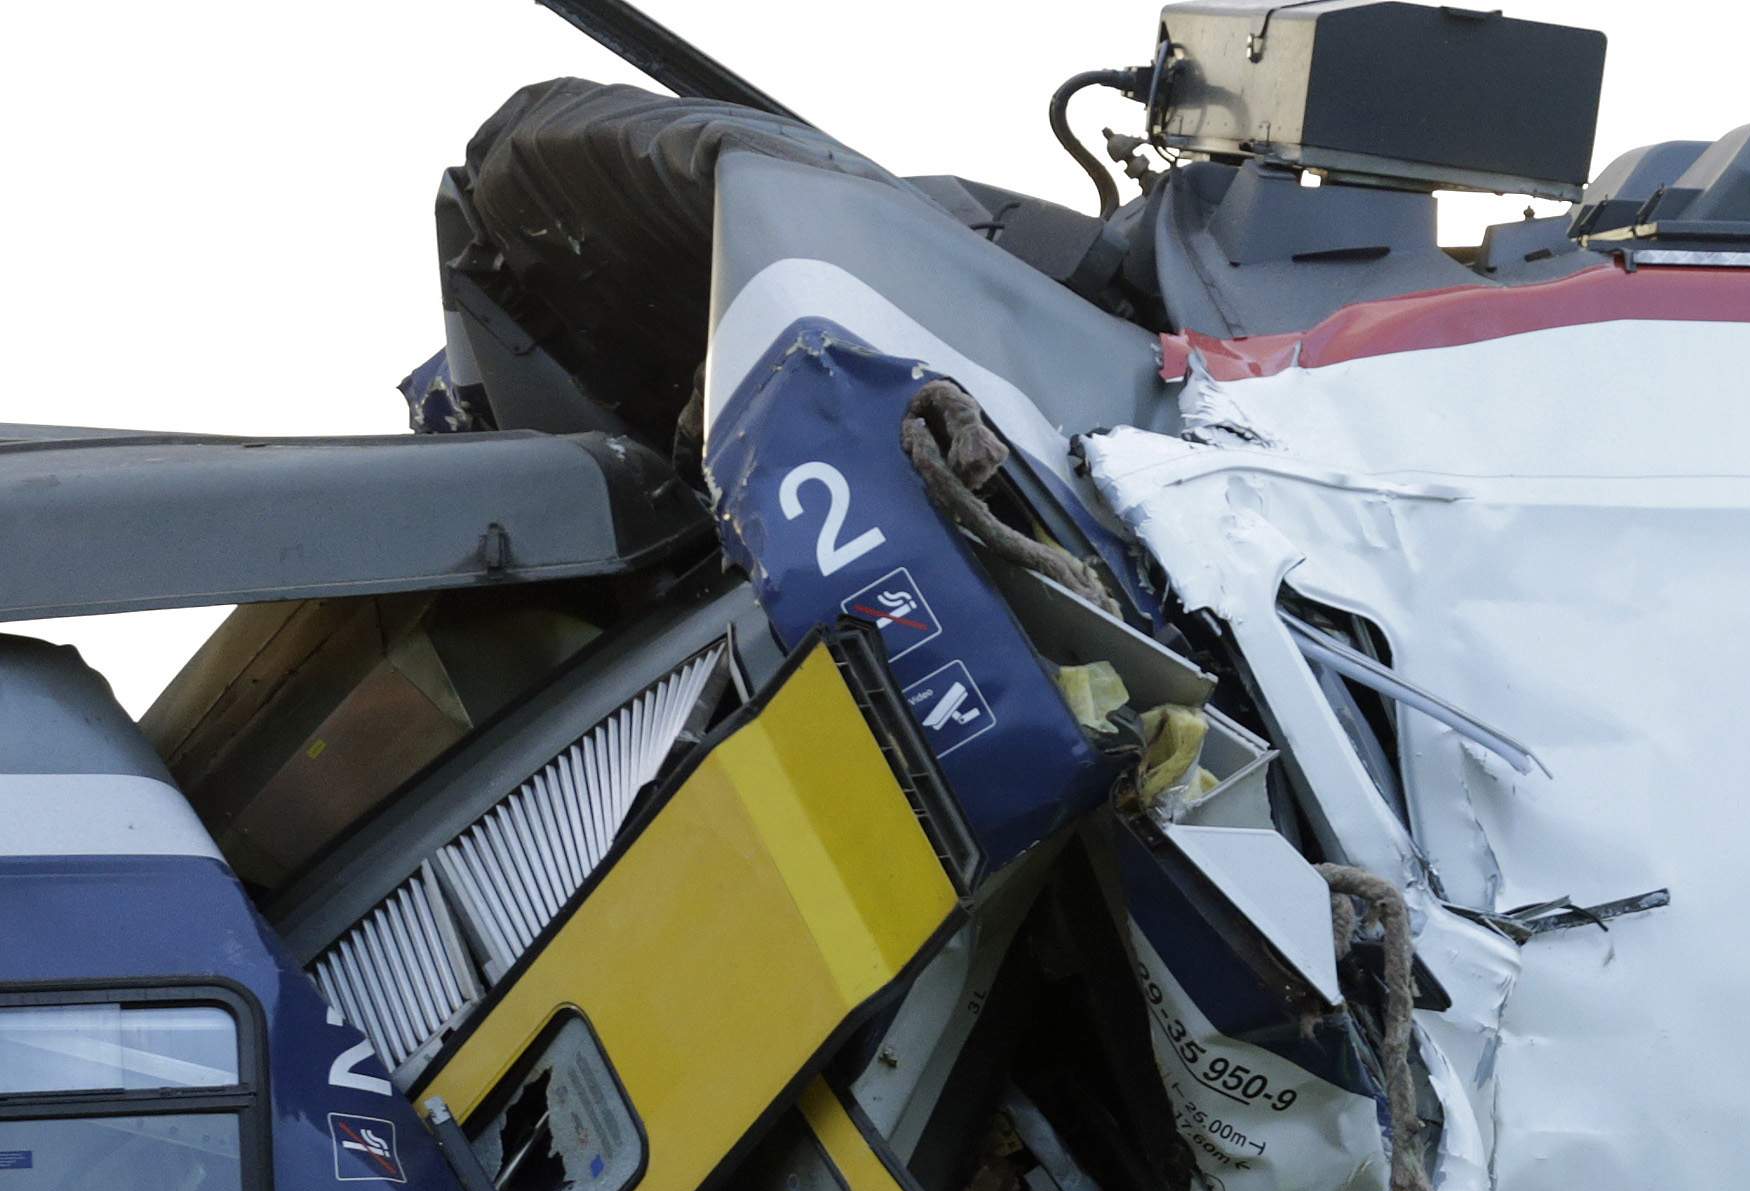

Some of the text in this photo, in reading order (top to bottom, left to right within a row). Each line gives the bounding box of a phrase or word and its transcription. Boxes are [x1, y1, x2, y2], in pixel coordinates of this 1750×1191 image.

[779, 461, 886, 577] 2
[907, 688, 934, 706] Video
[1203, 1057, 1298, 1112] 950-9
[1183, 1103, 1248, 1148] 25.00m
